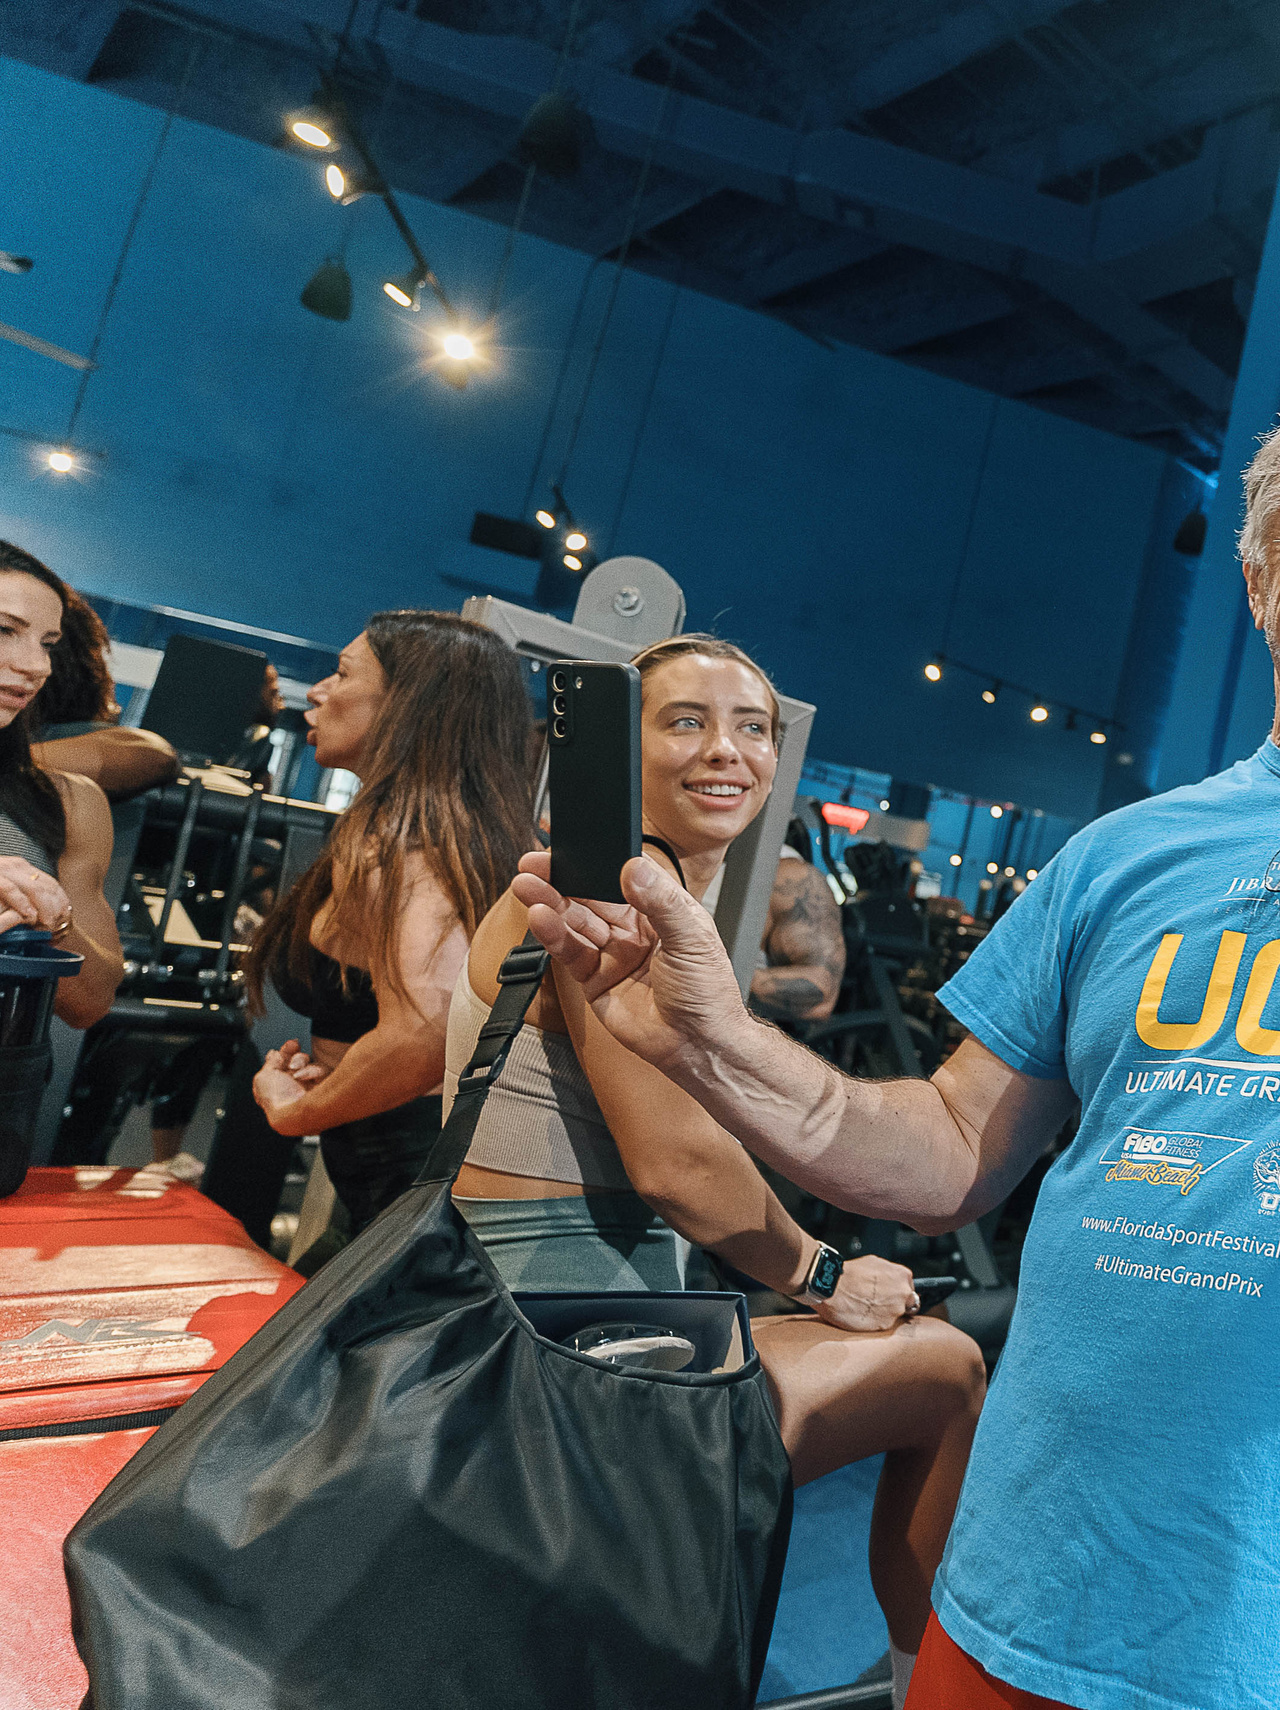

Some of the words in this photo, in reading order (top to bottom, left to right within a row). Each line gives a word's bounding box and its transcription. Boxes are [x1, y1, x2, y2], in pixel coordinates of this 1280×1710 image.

[1125, 1069, 1236, 1096] ULTIMATE
[1123, 1133, 1168, 1154] FIBO
[1167, 1136, 1204, 1150] GLOBAL
[1163, 1145, 1202, 1158] FITNESS
[1105, 1160, 1150, 1182] Miami
[1146, 1161, 1203, 1196] Beach
[1094, 1254, 1264, 1298] #UltimateGrandPrix
